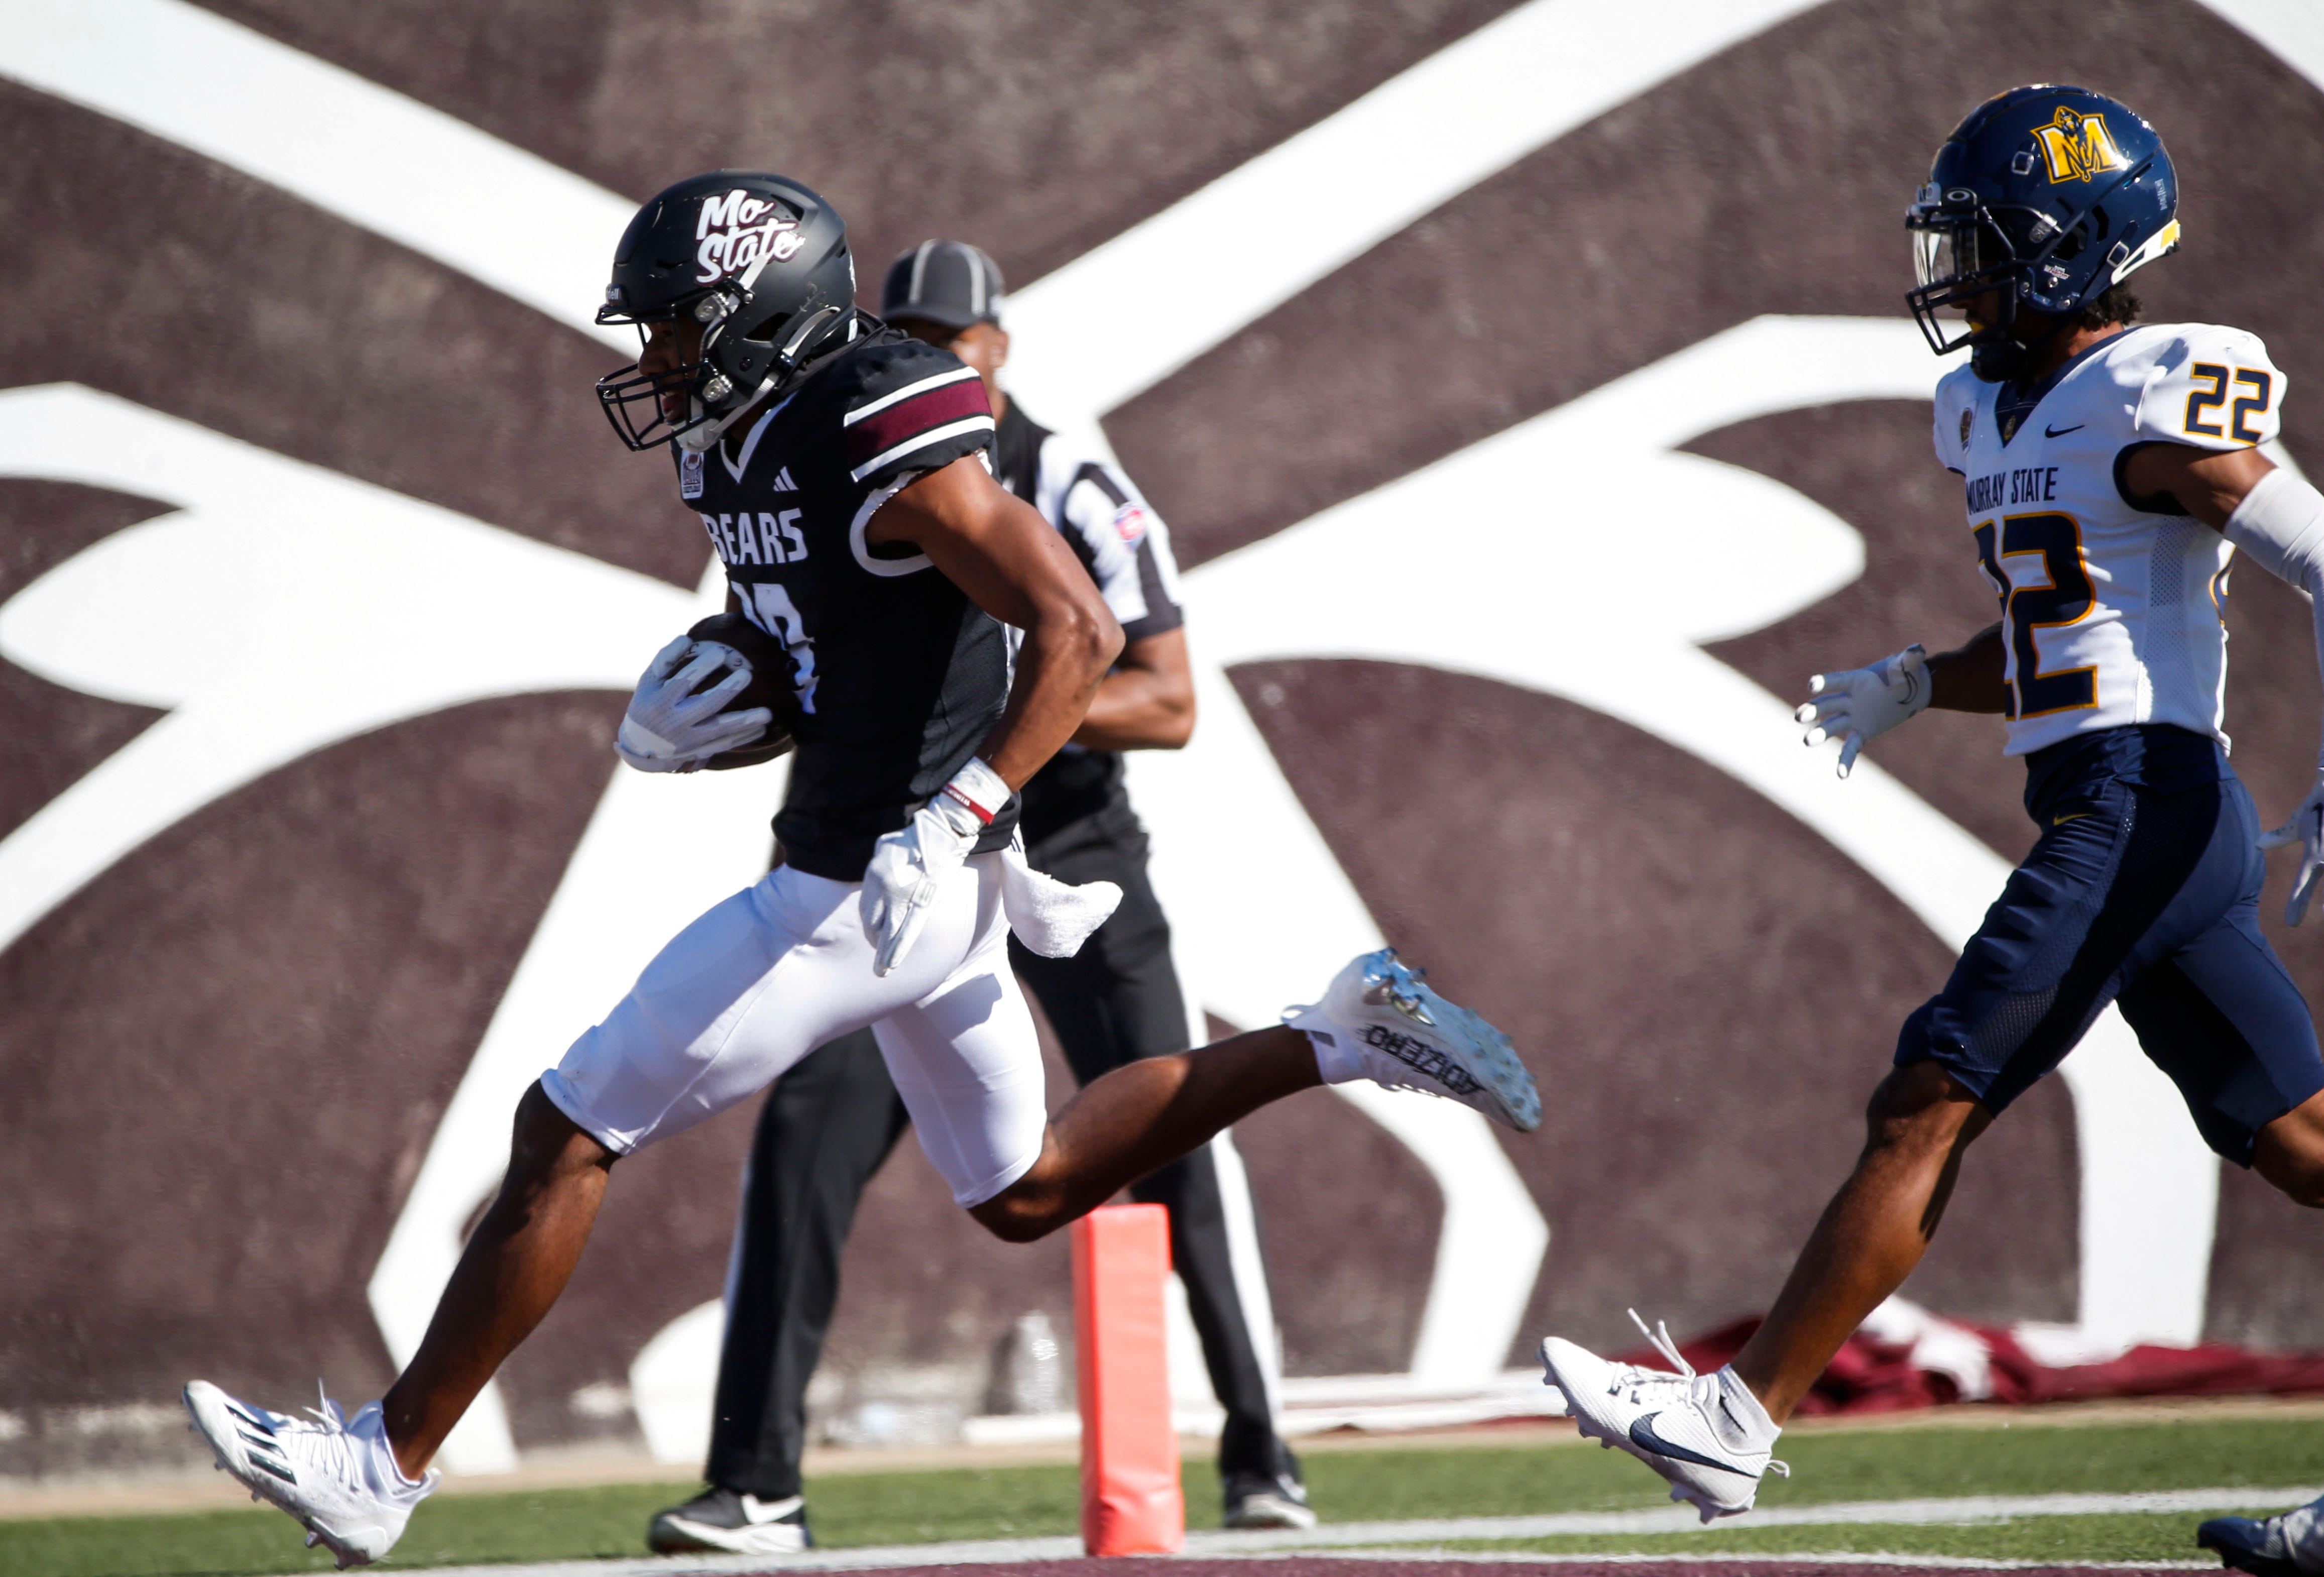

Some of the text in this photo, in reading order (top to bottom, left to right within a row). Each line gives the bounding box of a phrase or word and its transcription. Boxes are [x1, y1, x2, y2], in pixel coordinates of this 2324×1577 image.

[695, 189, 774, 240] Mo
[696, 217, 806, 283] State
[2183, 361, 2272, 446] 22
[1966, 467, 2059, 515] MURRAY STATE
[701, 507, 808, 565] BEARS
